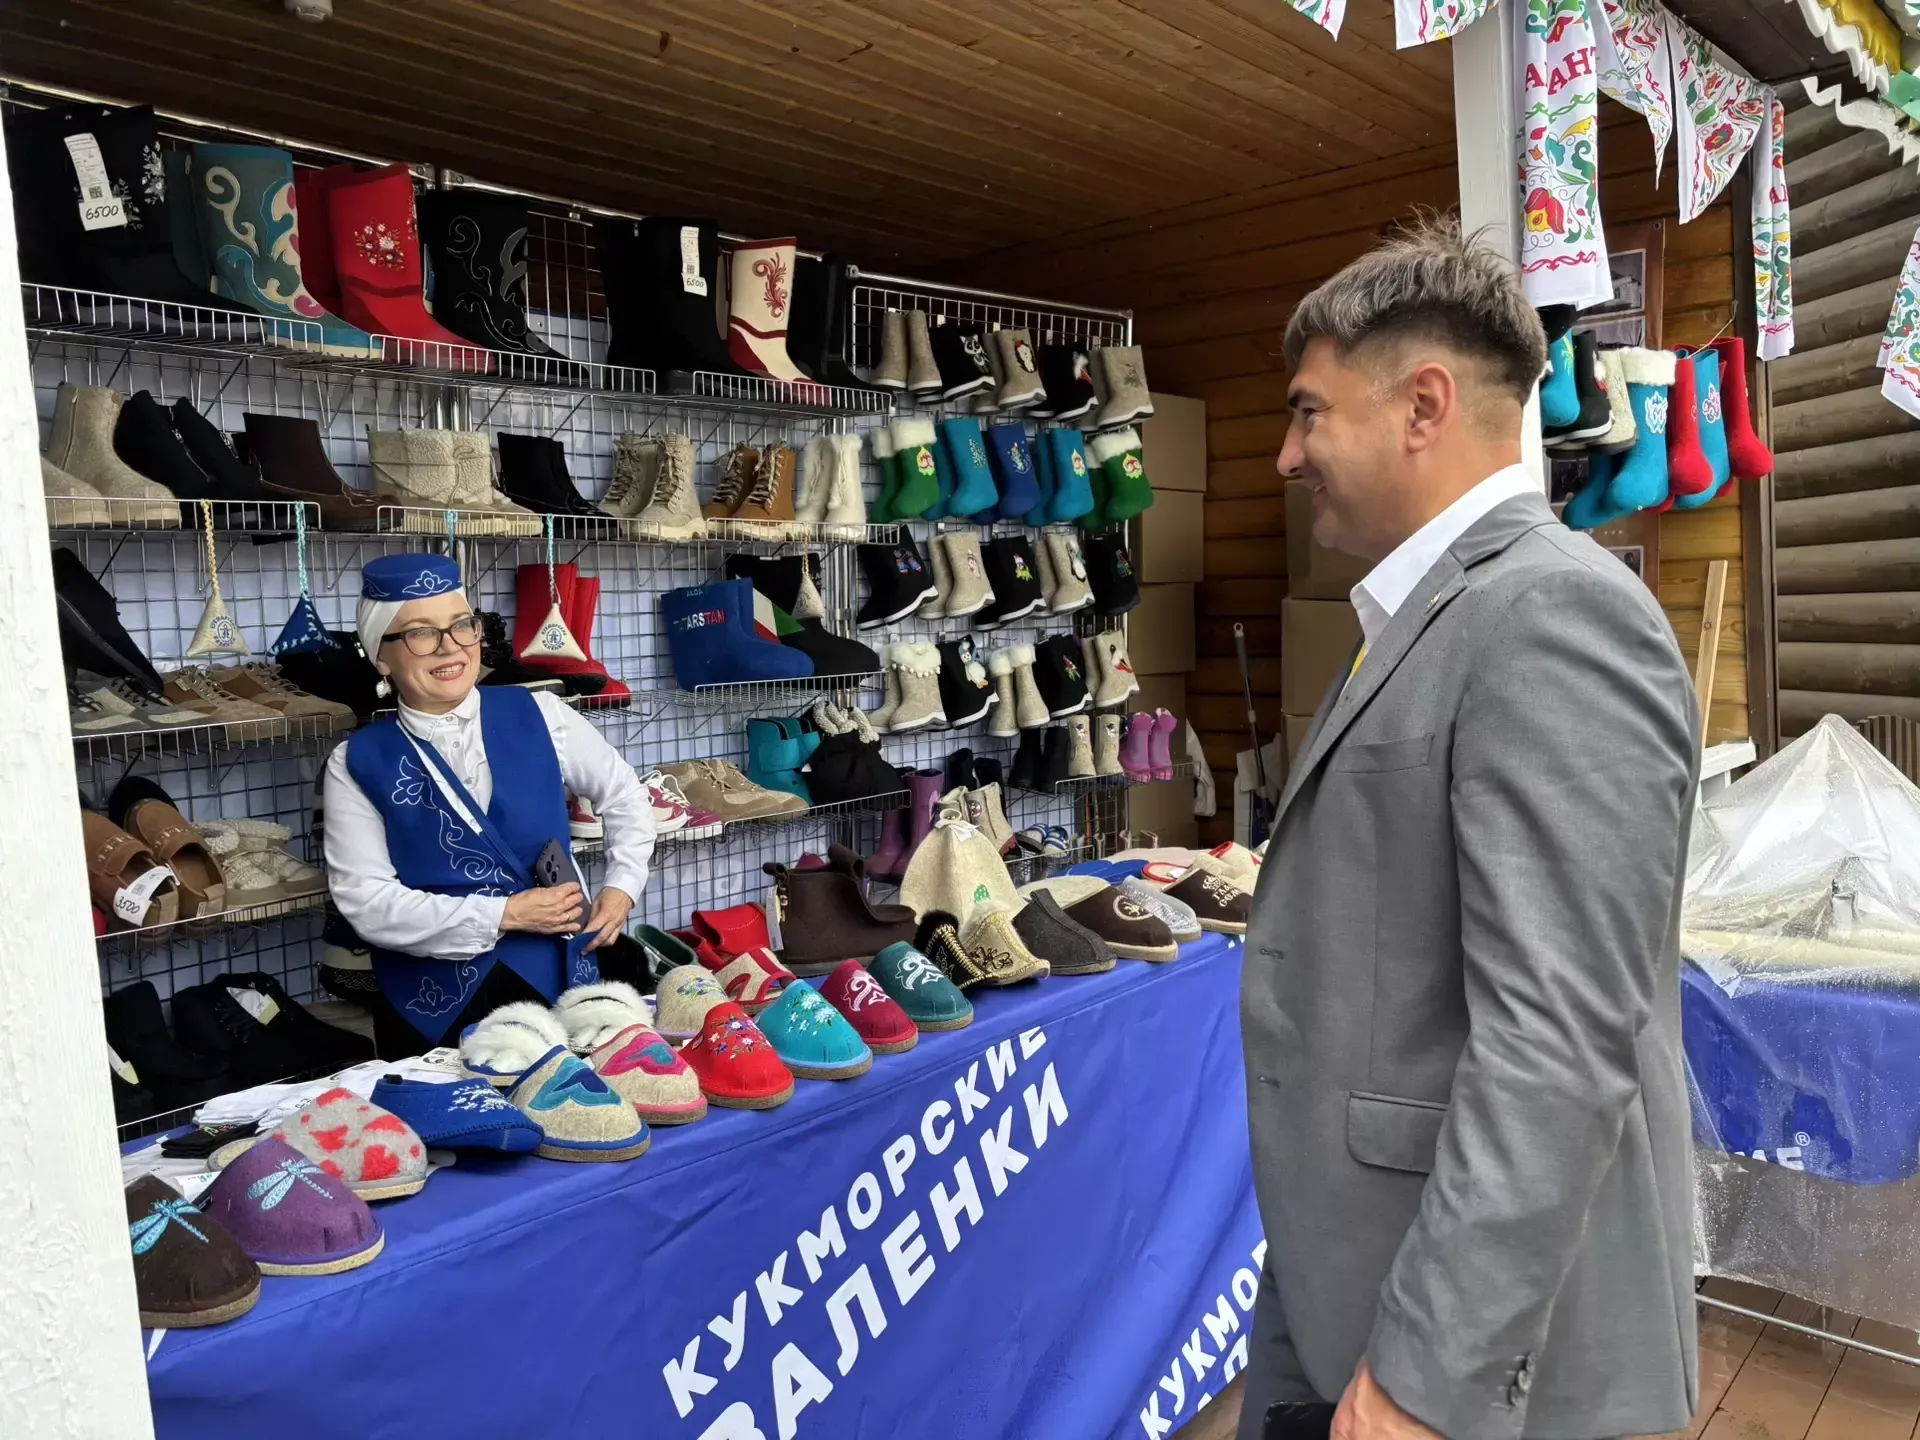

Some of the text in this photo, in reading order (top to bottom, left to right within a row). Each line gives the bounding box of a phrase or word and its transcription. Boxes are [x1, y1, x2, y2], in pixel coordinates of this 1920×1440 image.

[86, 205, 119, 220] 6500
[686, 277, 704, 287] 6500
[115, 896, 141, 914] 3500
[663, 1026, 1047, 1418] КУКМОРСКИЕ
